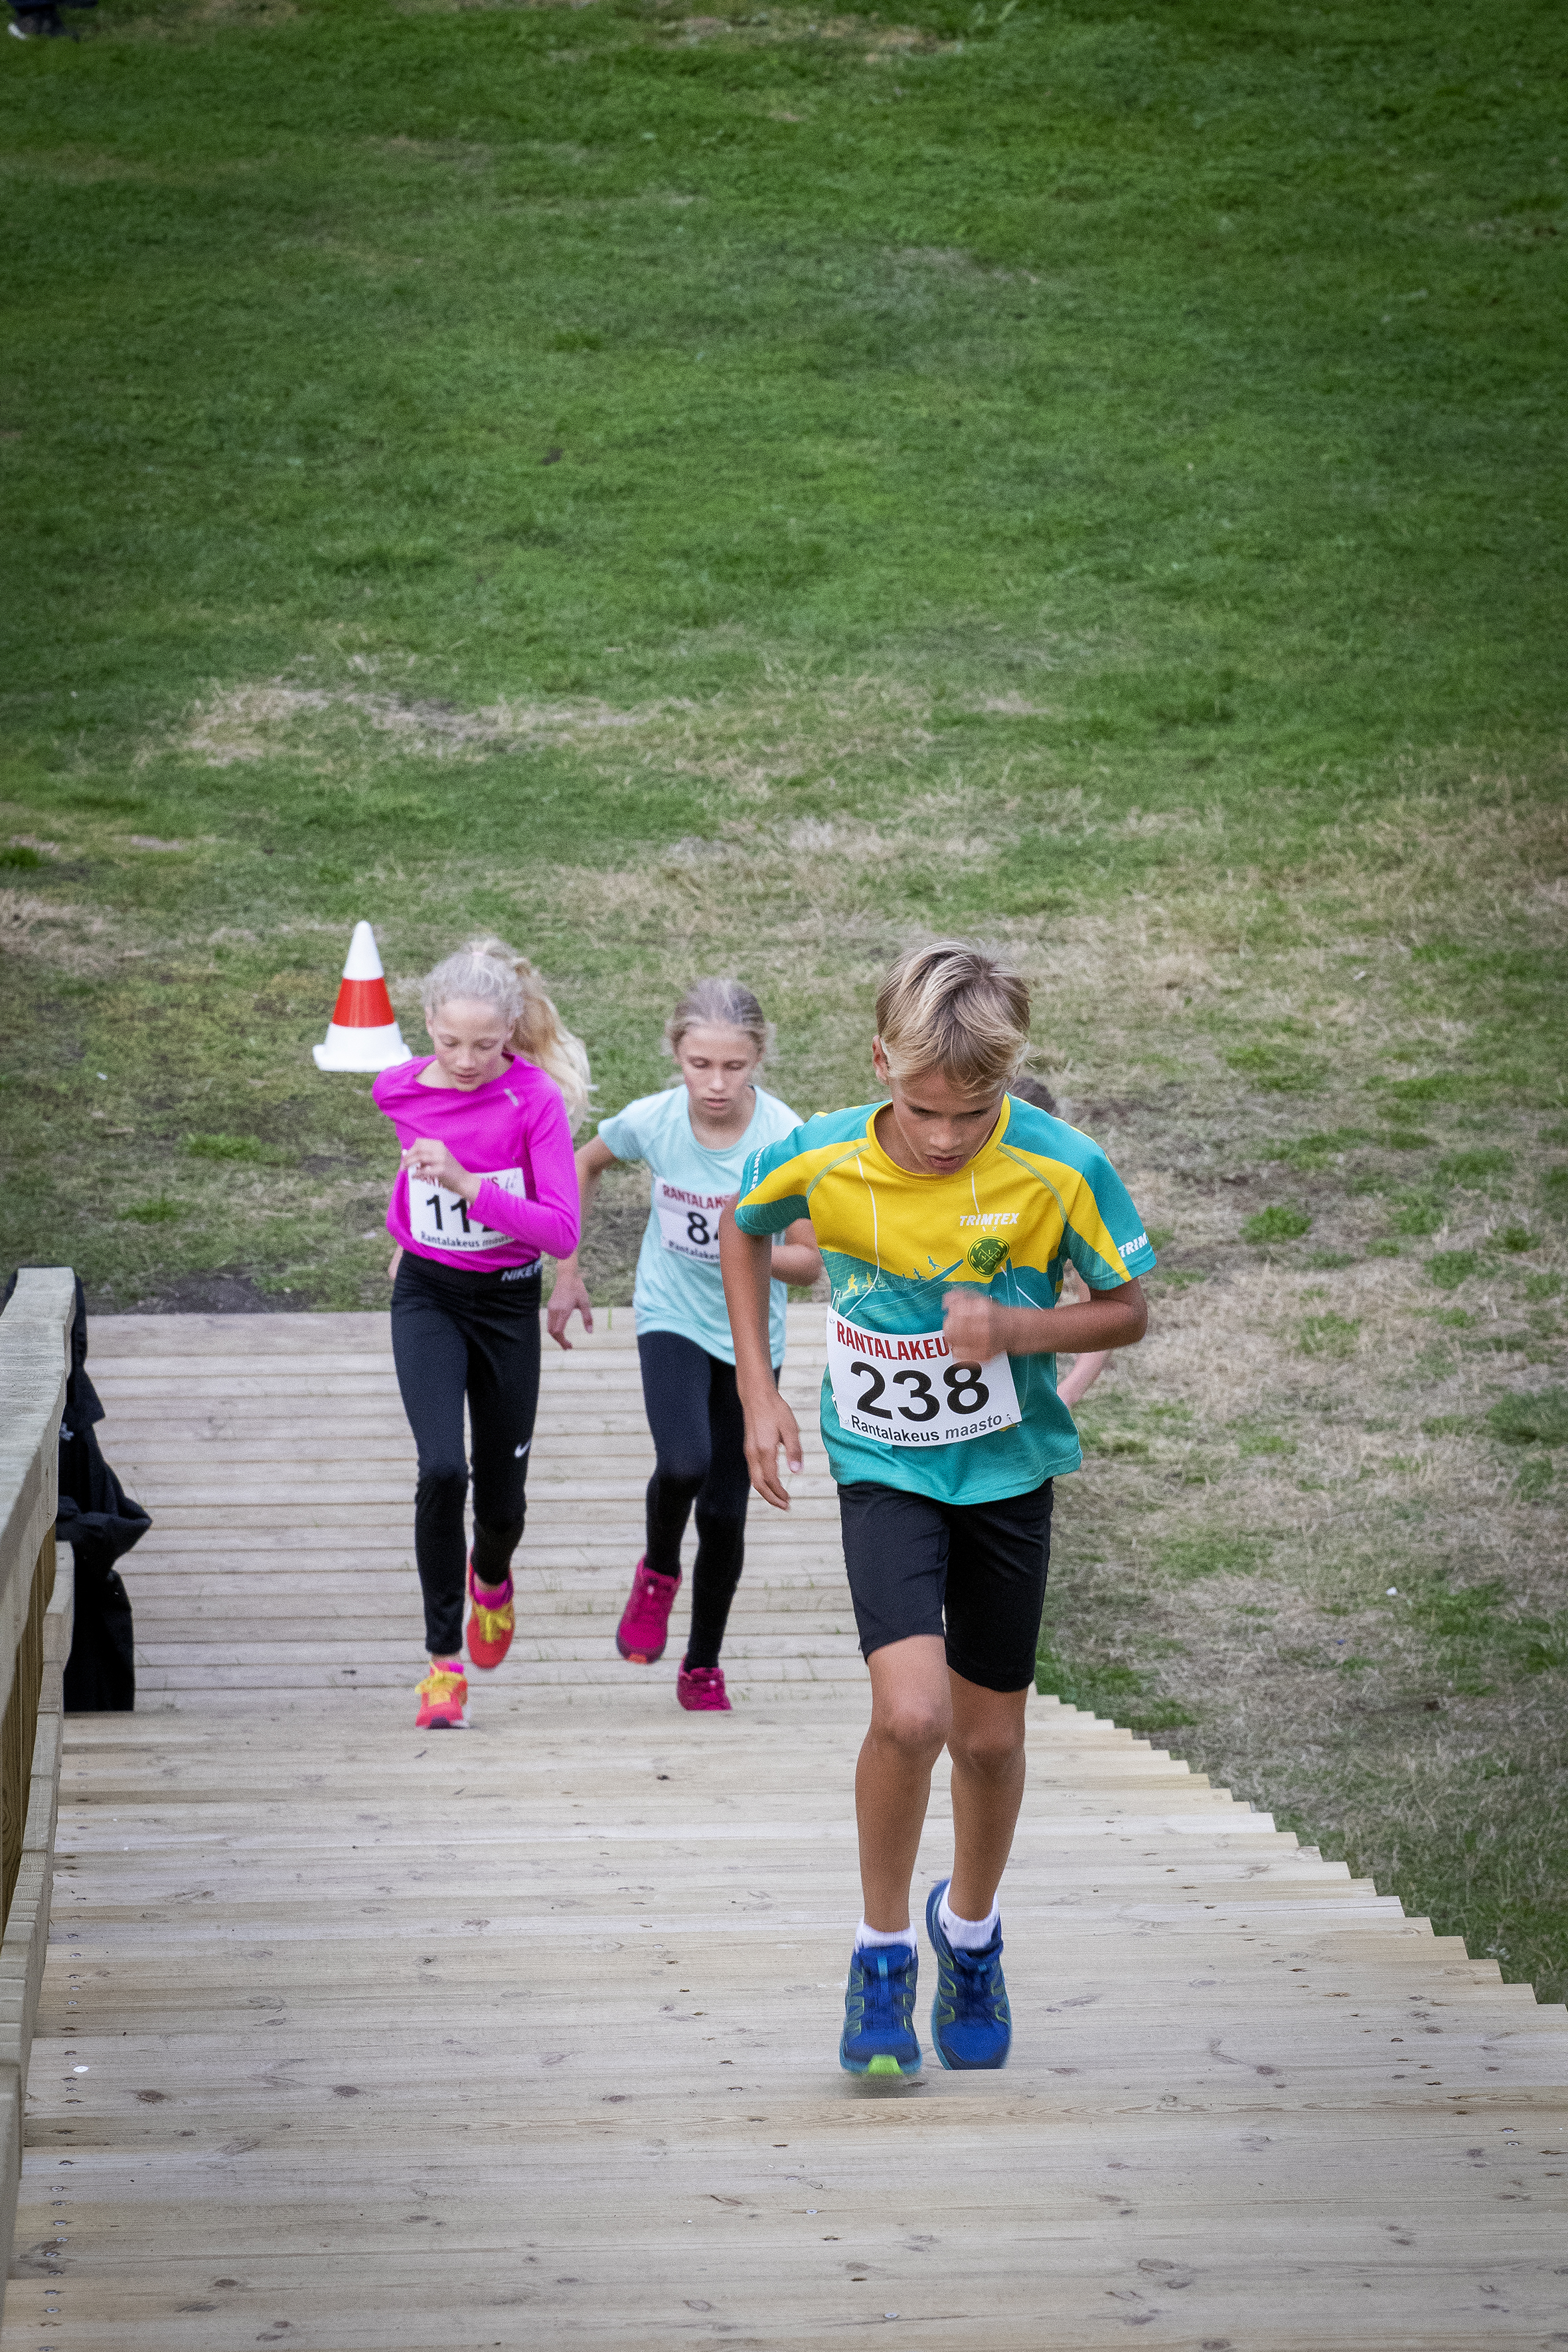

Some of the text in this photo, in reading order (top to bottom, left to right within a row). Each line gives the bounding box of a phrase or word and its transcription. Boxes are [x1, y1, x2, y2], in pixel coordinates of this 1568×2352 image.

[663, 1184, 724, 1210] RANTALAK
[426, 1194, 496, 1233] 11
[960, 1212, 1020, 1227] TRIMTEX
[421, 1231, 480, 1248] Rantalakeus
[687, 1212, 719, 1245] 8
[1118, 1231, 1148, 1258] TRIM
[836, 1320, 951, 1361] RANTALAKEU
[850, 1360, 990, 1422] 238
[851, 1414, 1002, 1443] Rantalakeus maasto
